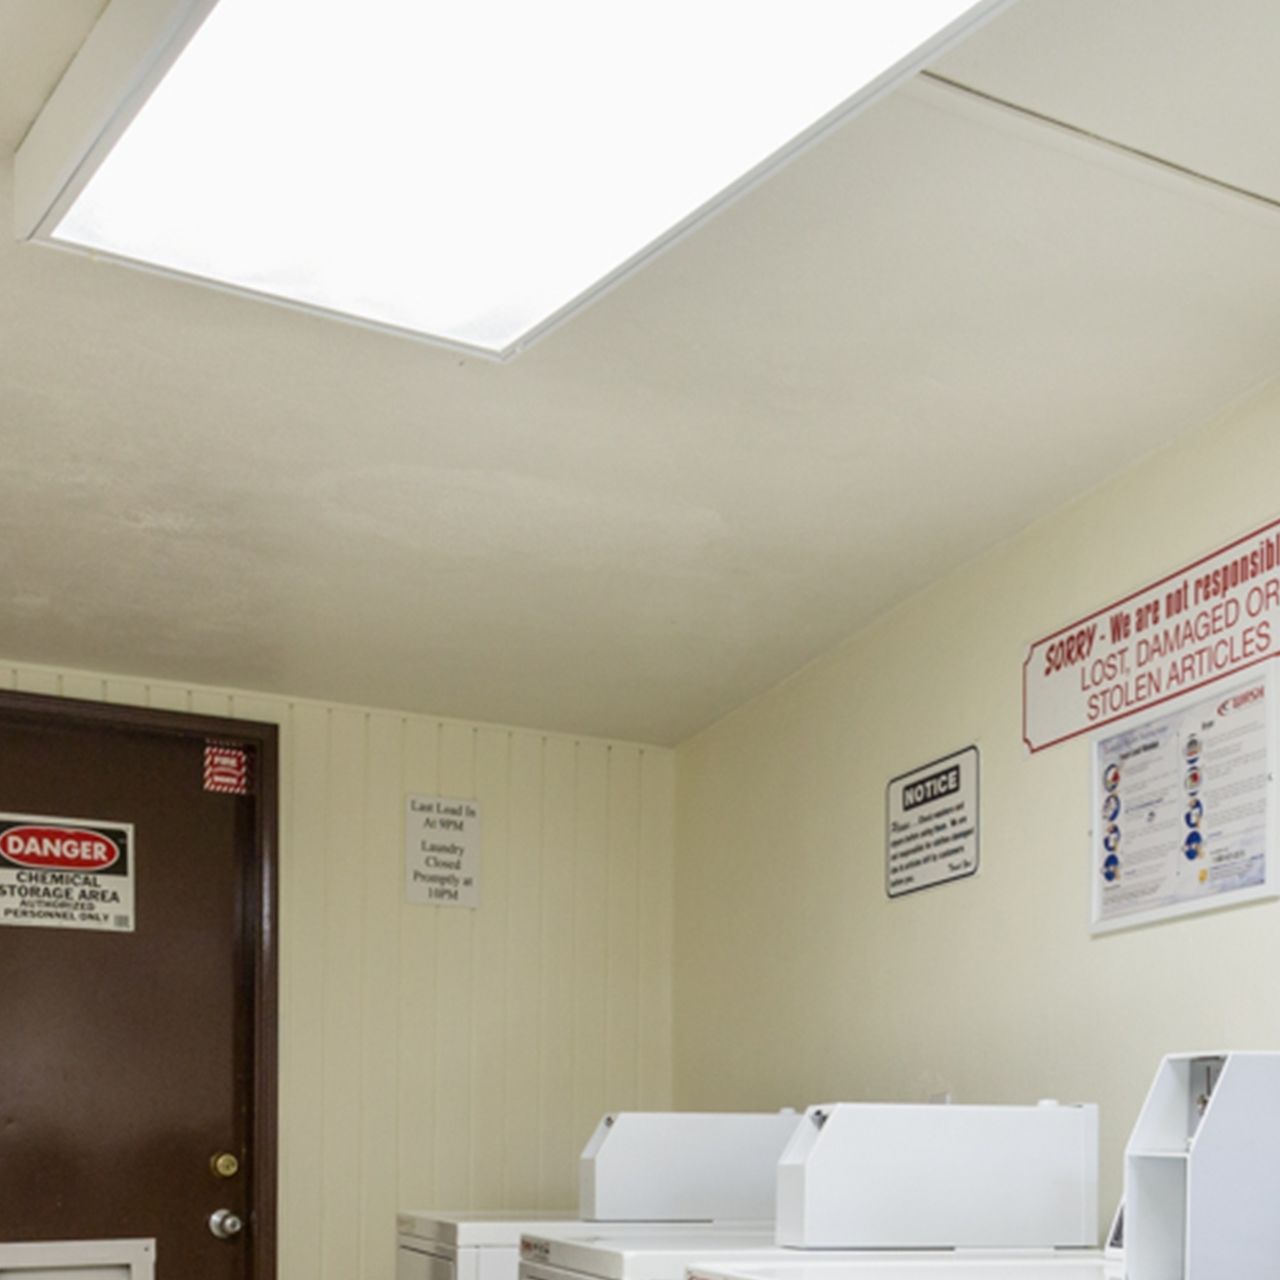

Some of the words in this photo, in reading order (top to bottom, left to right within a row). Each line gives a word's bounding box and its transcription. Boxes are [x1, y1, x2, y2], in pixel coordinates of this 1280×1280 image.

[1044, 624, 1098, 676] SORRY
[1110, 611, 1131, 644] We
[1135, 599, 1160, 633] are
[1165, 580, 1189, 617] not
[1081, 644, 1130, 691] LOST,
[1137, 597, 1240, 668] DAMAGED
[1246, 578, 1280, 615] OR
[1087, 668, 1161, 721] STOLEN
[1165, 621, 1272, 691] ARTICLES
[905, 770, 957, 806] NOTICE
[410, 799, 433, 812] Last
[436, 803, 463, 816] Load
[465, 805, 477, 818] In
[423, 818, 436, 829] At
[439, 818, 464, 831] 9PM
[6, 835, 108, 861] DANGER
[421, 840, 465, 857] Laundry
[424, 856, 461, 870] Closed
[16, 871, 101, 887] CHEMICAL
[413, 870, 460, 887] Promptly
[463, 876, 473, 887] at
[78, 888, 120, 903] AREA
[428, 887, 459, 901] 10PM
[19, 899, 96, 911] AUTHORIZED
[3, 908, 77, 921] PERSONNEL
[79, 911, 110, 922] ONLY
